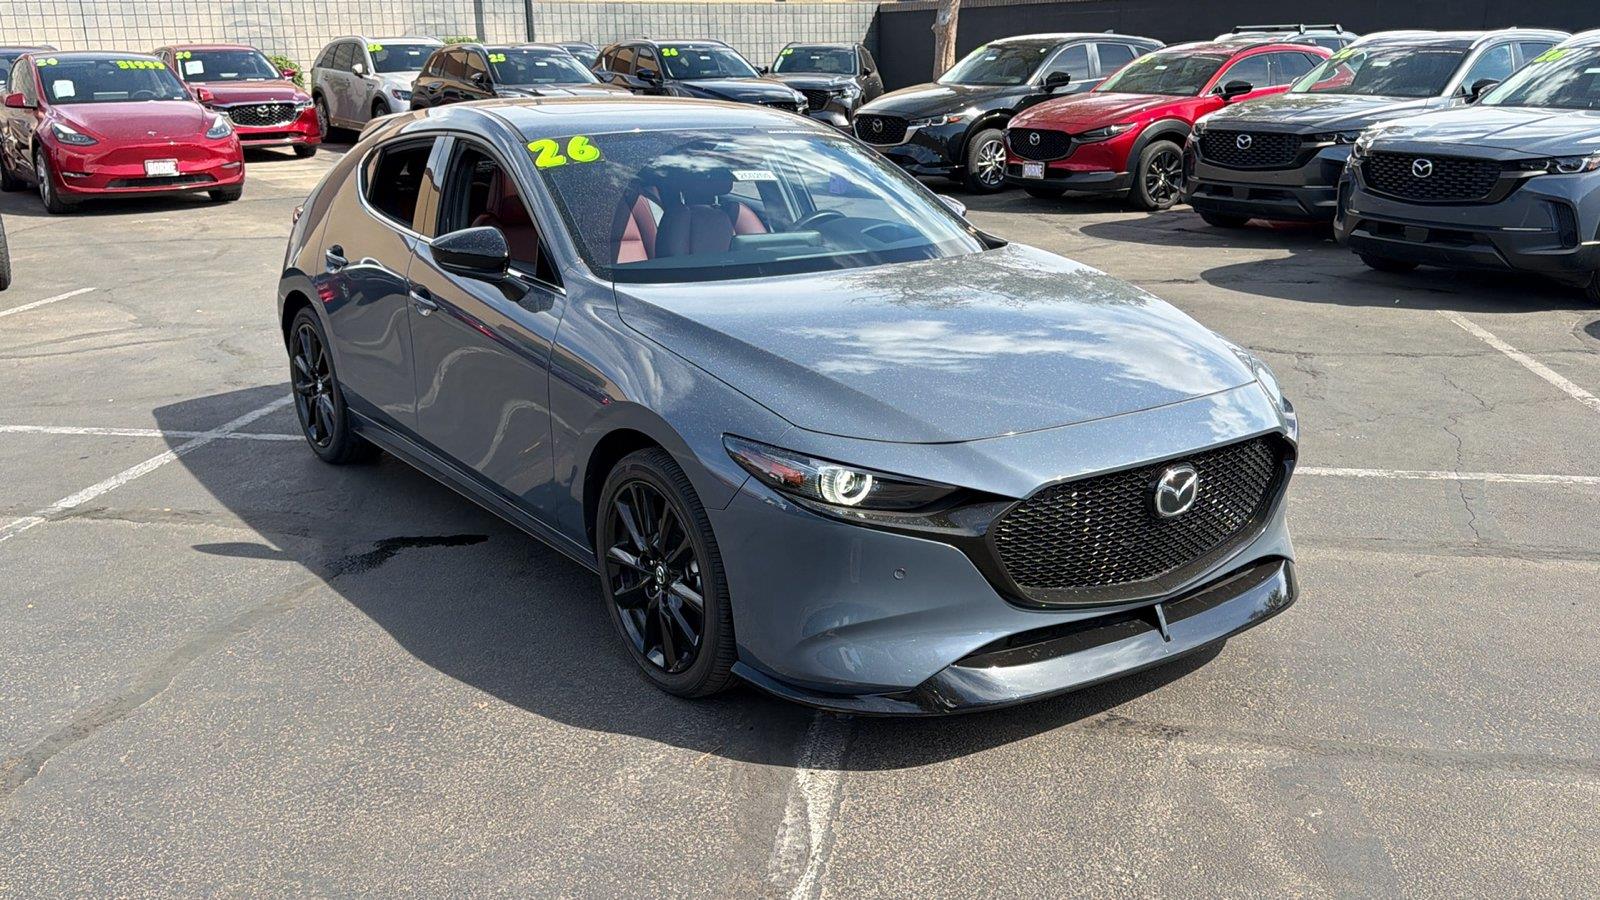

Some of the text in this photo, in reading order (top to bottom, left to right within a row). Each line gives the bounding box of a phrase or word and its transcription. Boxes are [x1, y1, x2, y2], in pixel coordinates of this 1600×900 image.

[661, 47, 678, 57] 26
[488, 53, 506, 63] 25
[527, 135, 600, 168] 26
